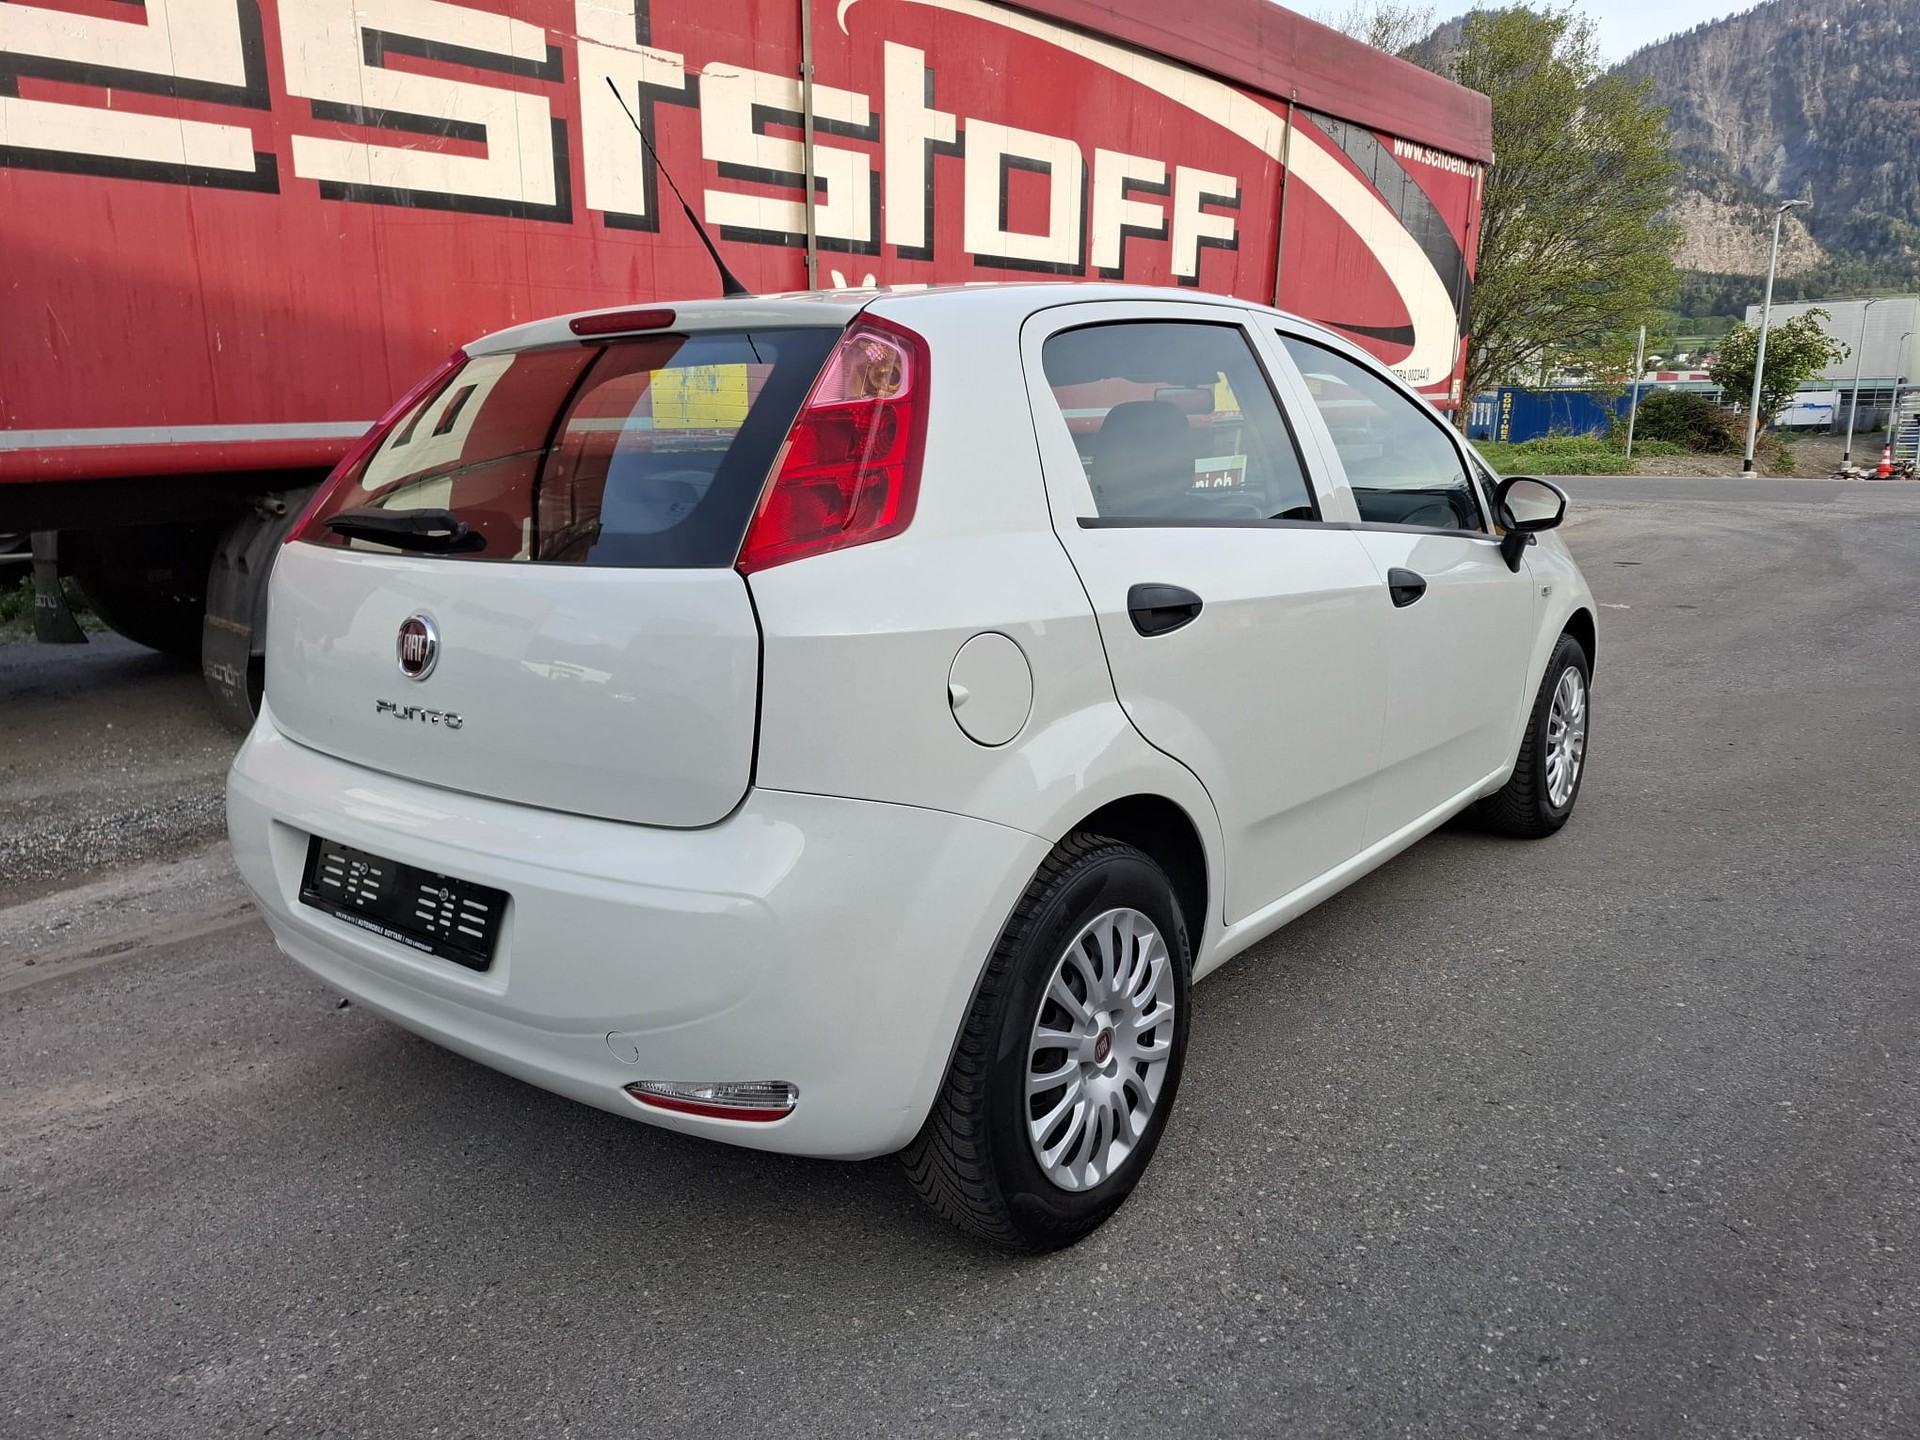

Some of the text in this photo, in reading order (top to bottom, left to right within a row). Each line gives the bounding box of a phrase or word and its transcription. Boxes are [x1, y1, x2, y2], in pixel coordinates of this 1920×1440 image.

[1500, 392, 1512, 440] CONTAINEX
[403, 633, 426, 662] FIAT
[376, 698, 463, 730] PUNTO
[358, 918, 384, 934] AUTOMOBILE
